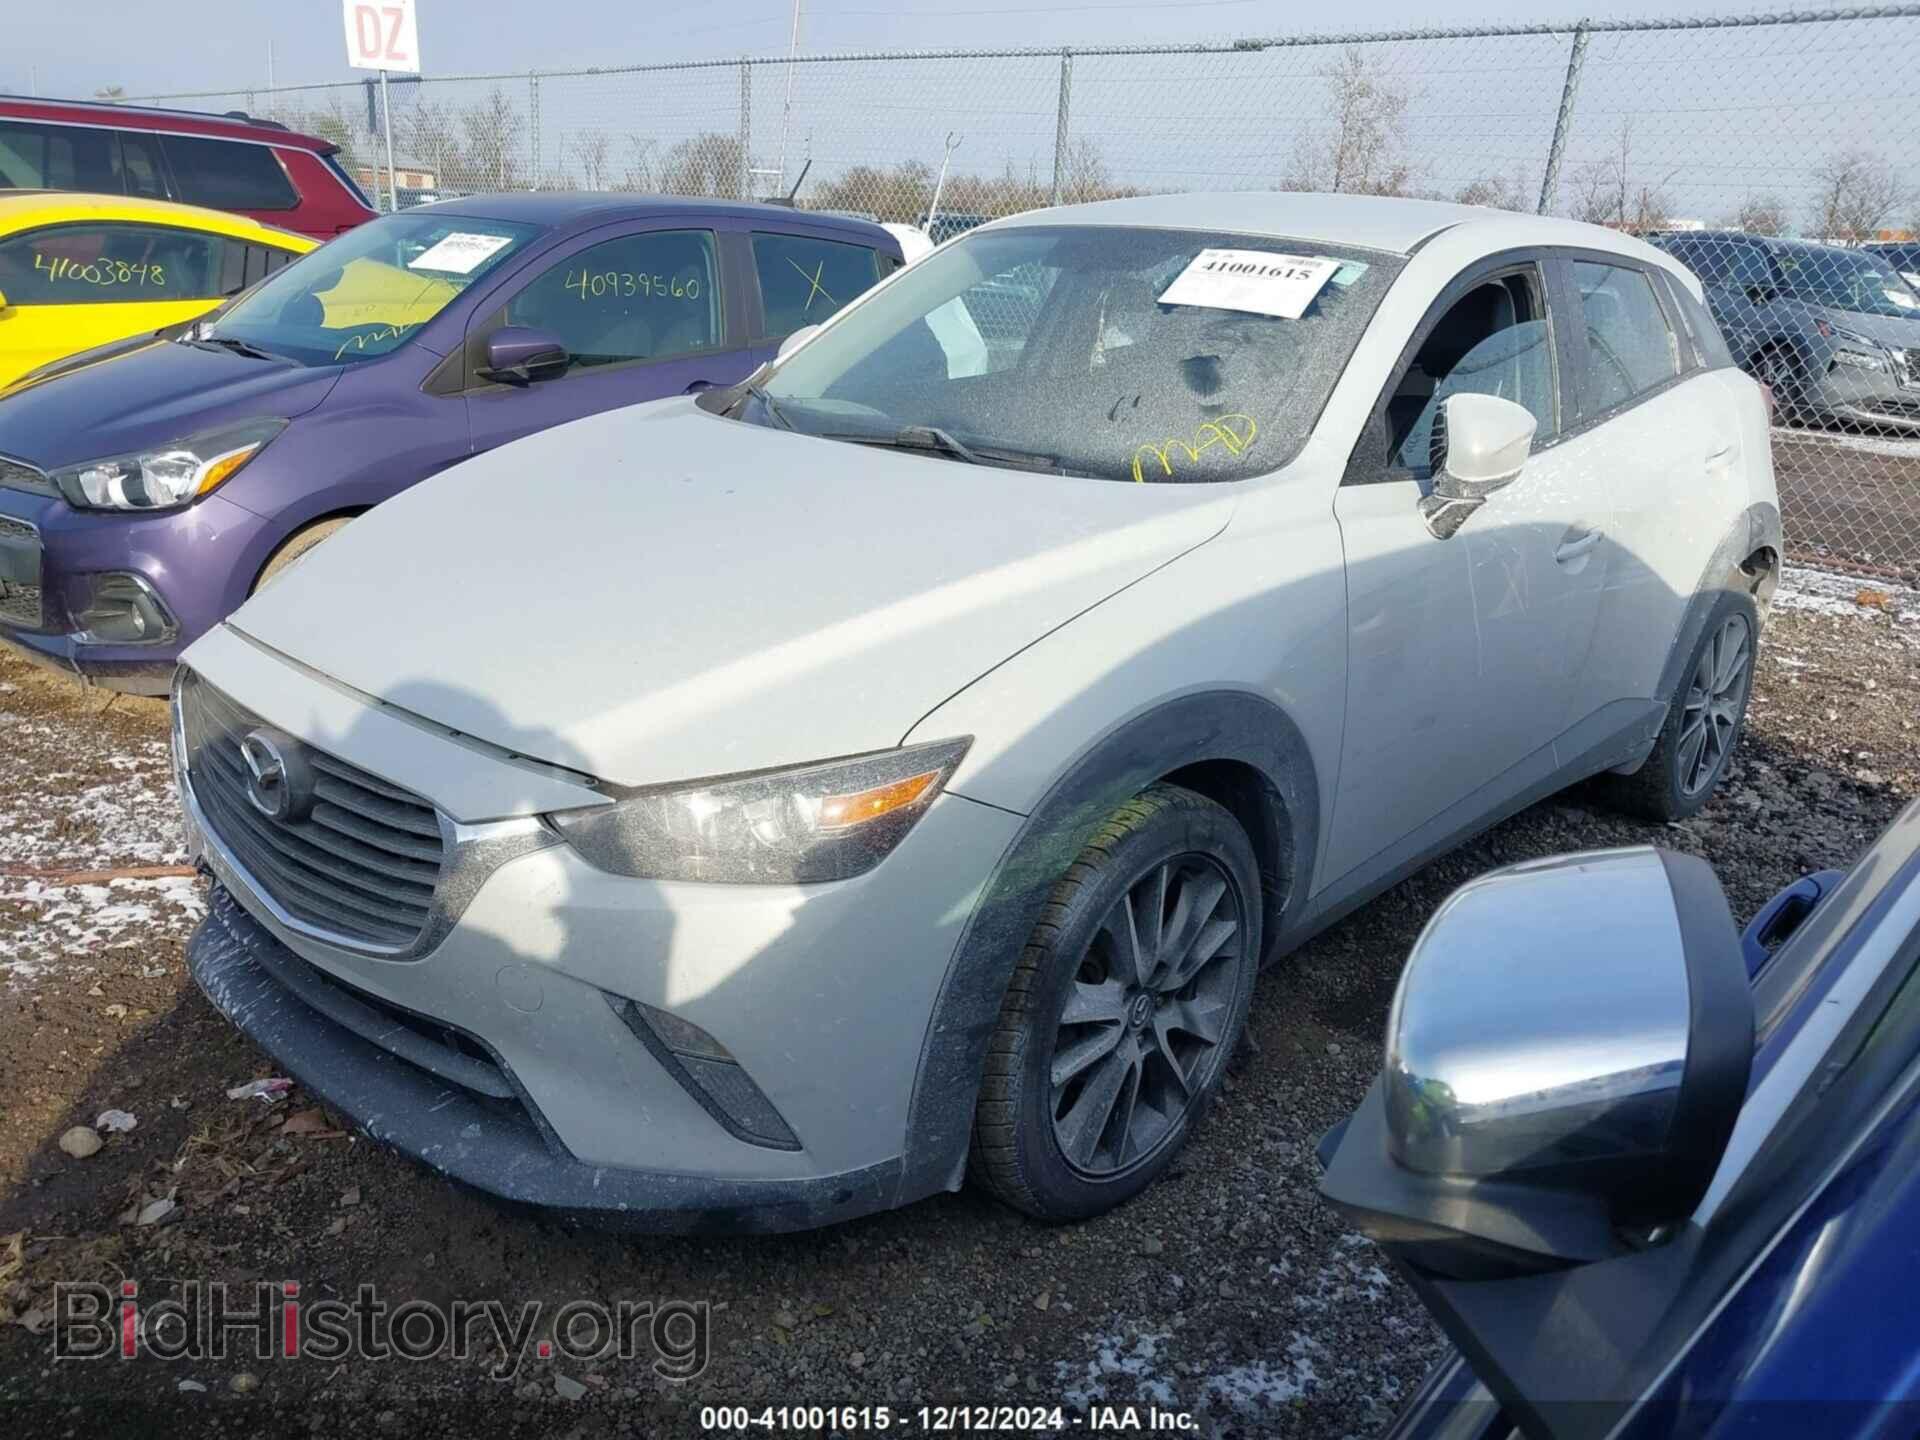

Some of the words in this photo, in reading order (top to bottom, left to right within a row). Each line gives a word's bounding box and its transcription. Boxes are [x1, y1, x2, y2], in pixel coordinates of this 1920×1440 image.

[355, 5, 408, 60] DZ
[34, 254, 166, 286] 41003848
[564, 268, 700, 300] 40939560
[1203, 260, 1312, 280] 41001615
